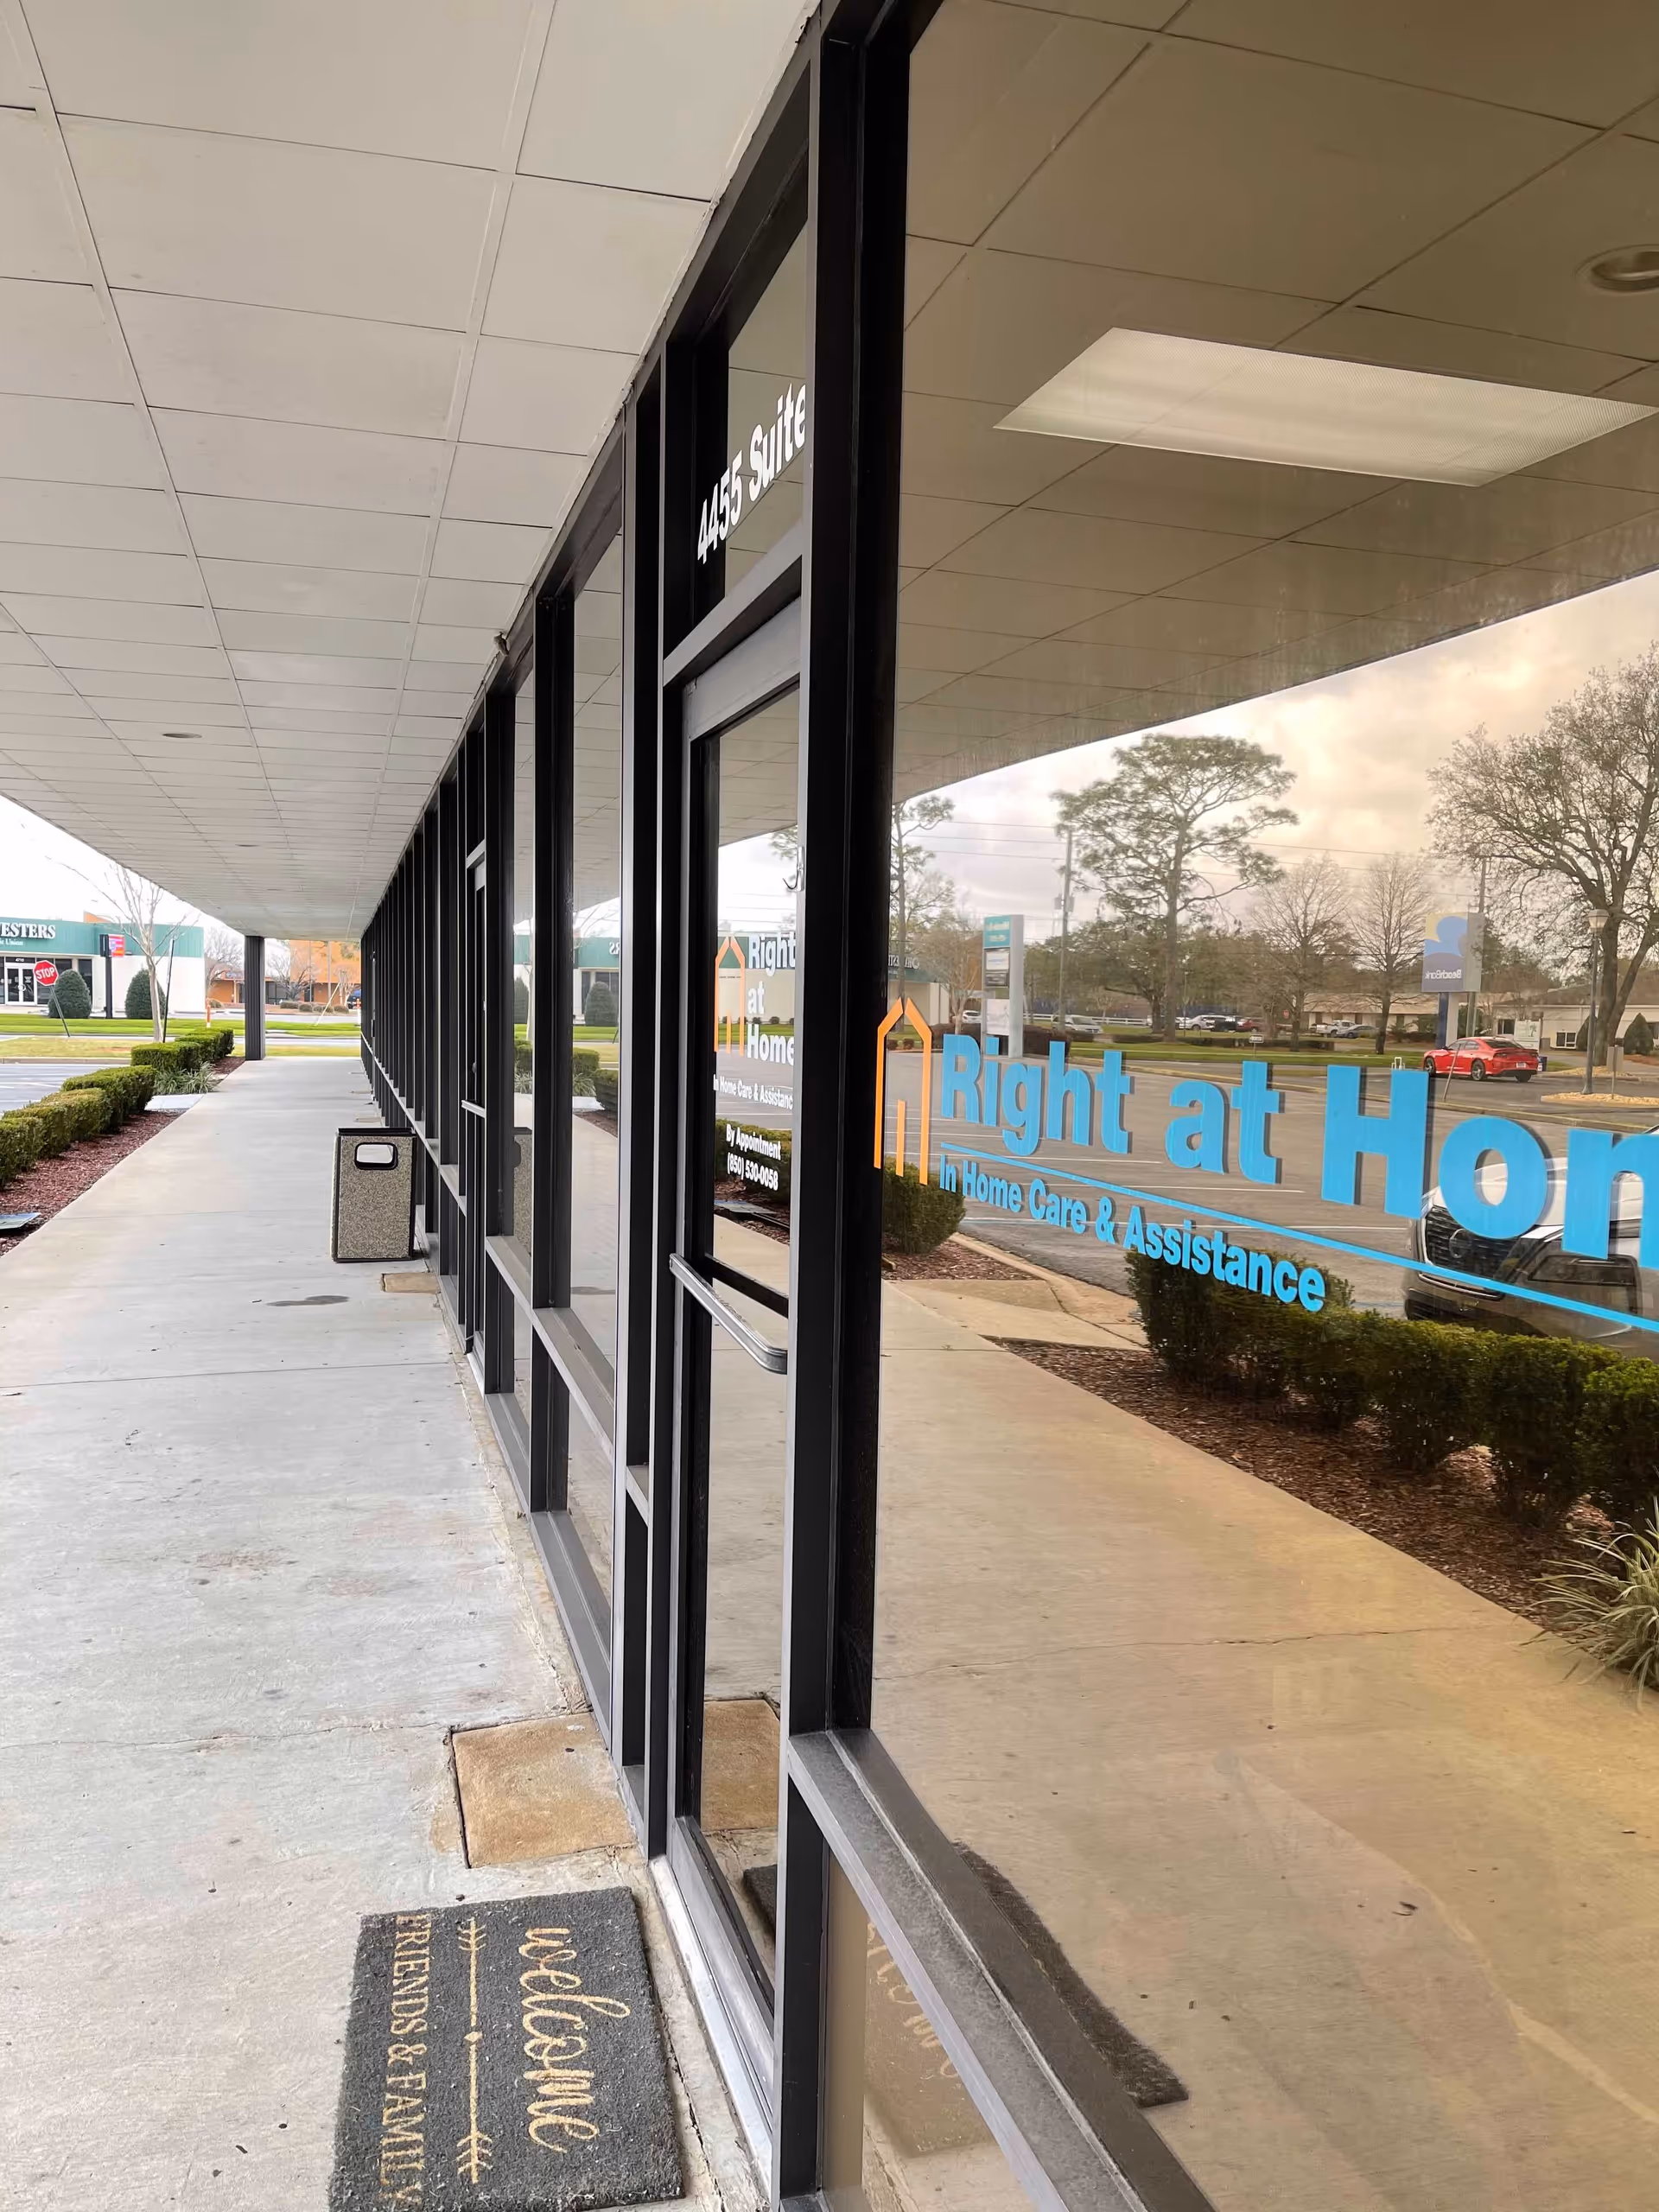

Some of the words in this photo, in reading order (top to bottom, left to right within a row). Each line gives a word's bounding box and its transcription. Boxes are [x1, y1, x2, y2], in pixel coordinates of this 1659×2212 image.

[697, 449, 742, 564] 4455
[748, 383, 806, 501] Suite
[0, 921, 56, 939] ESTERS
[35, 967, 55, 980] STOP
[748, 931, 796, 976] Right
[747, 981, 765, 1014] at
[747, 1024, 794, 1065] Home
[713, 1074, 719, 1091] In
[720, 1076, 736, 1096] Home
[738, 1080, 753, 1100] Care
[753, 1083, 759, 1102] &
[760, 1084, 793, 1110] Assistanc
[941, 1033, 1131, 1156] Right
[1165, 1060, 1281, 1185] at
[726, 1123, 734, 1147] By
[735, 1127, 781, 1160] Appointment
[727, 1152, 745, 1180] (850)
[745, 1160, 779, 1191] 530-0058
[939, 1154, 957, 1192] In
[962, 1160, 1022, 1213] Home
[1028, 1179, 1087, 1235] Care
[1095, 1196, 1116, 1245] &
[1123, 1206, 1326, 1313] Assistance
[389, 1914, 431, 2035] FRIENDS
[387, 2043, 428, 2067] &
[518, 1927, 631, 2153] welcome
[378, 2072, 427, 2205] FAMILY
